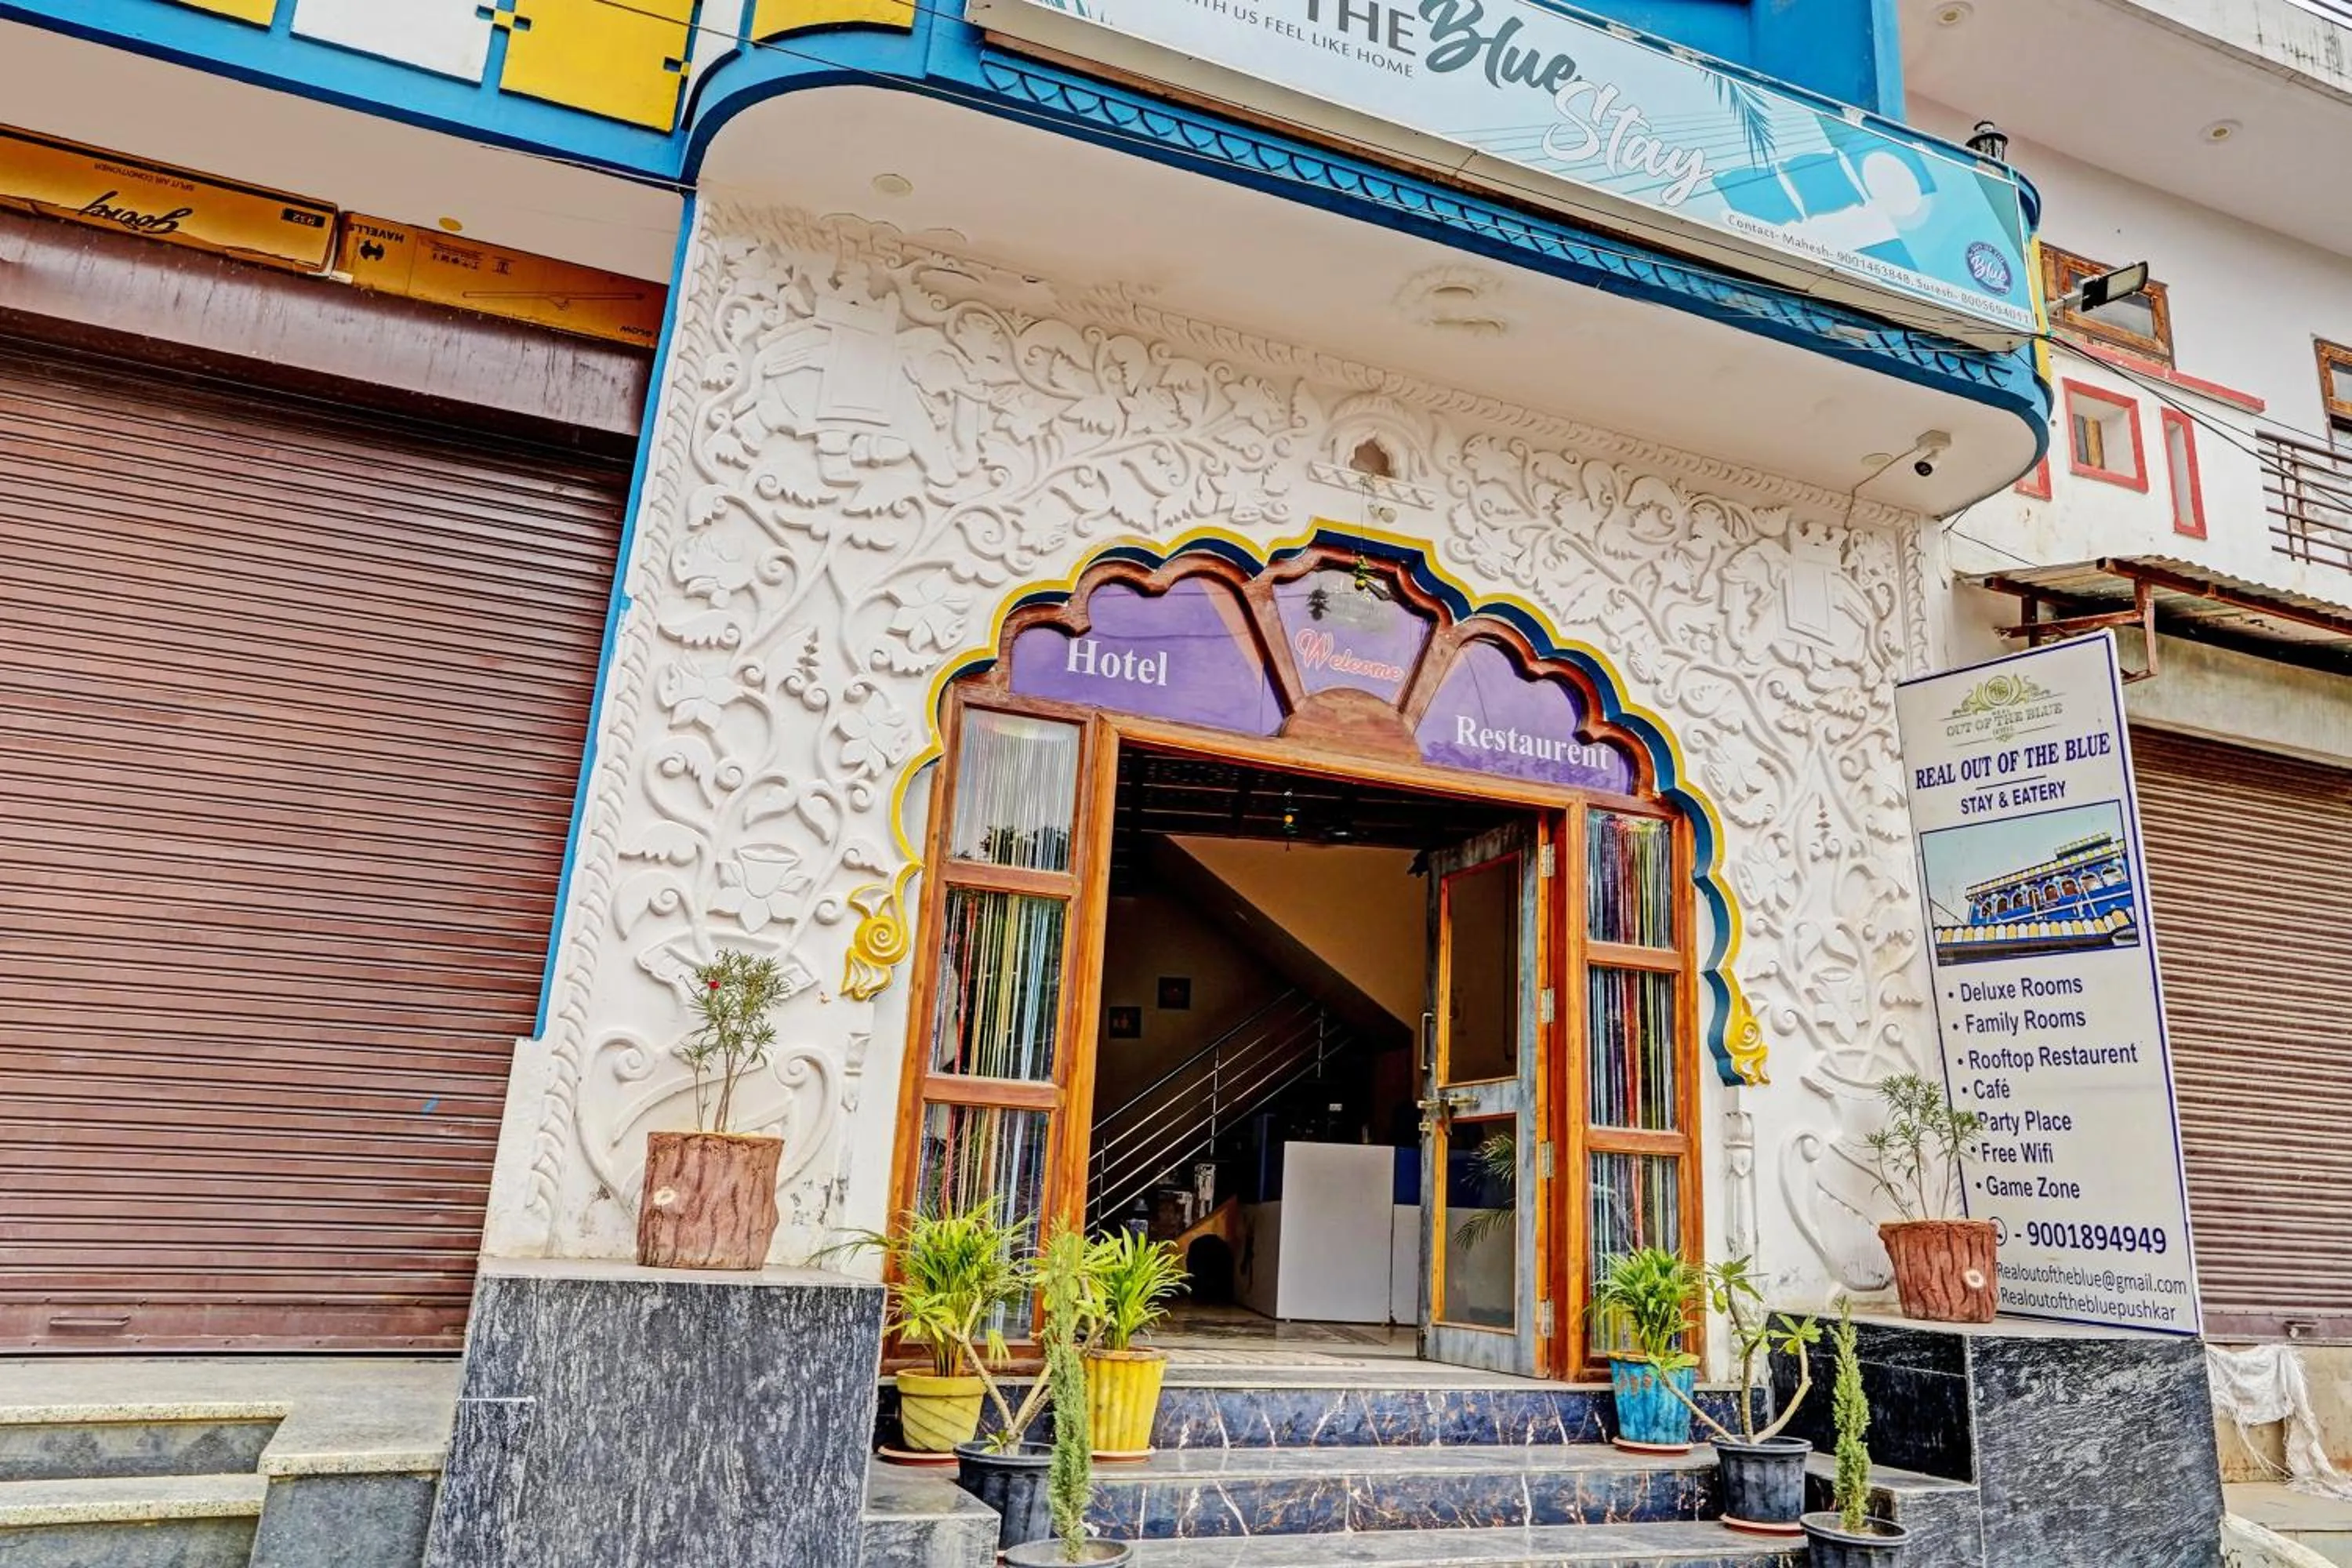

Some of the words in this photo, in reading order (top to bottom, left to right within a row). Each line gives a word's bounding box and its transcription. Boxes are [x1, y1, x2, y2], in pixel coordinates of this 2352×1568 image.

[1233, 5, 1259, 25] US
[1264, 16, 1305, 42] FEEL
[1312, 31, 1352, 56] LIKE
[1356, 47, 1414, 78] HOME
[1418, 0, 1582, 95] Blue
[1541, 78, 1716, 207] Stay
[347, 223, 405, 244] HAVELLS
[1066, 637, 1168, 687] Hotel
[1294, 628, 1405, 681] Welcome
[1947, 721, 1973, 737] OUT
[2025, 702, 2063, 720] BLUE
[1454, 714, 1609, 770] Restaurent
[1915, 764, 1956, 790] REAL
[1961, 755, 1992, 781] OUT
[1997, 750, 2020, 775] OF
[2024, 742, 2060, 769] THE
[2065, 732, 2111, 761] BLUE
[1961, 793, 1994, 815] STAY
[1998, 791, 2009, 809] &
[2013, 780, 2067, 806] EATERY
[1961, 981, 2016, 1003] Deluxe
[2020, 977, 2084, 998] Rooms
[1965, 1011, 2020, 1036] Family
[2024, 1009, 2086, 1030] Rooms
[1968, 1047, 2035, 1073] Rooftop
[2038, 1042, 2139, 1067] Restaurent
[1973, 1078, 2011, 1099] Café
[1977, 1111, 2020, 1136] Party
[2024, 1109, 2073, 1132] Place
[1981, 1142, 2017, 1163] Free
[2020, 1142, 2054, 1164] Wifi
[1986, 1175, 2034, 1197] Game
[2037, 1176, 2081, 1199] Zone
[2026, 1221, 2167, 1254] 9001894949
[1995, 1261, 2188, 1294] Realoutoftheblue@gmail.com
[2000, 1286, 2176, 1322] Realoutofthebluepushkar
